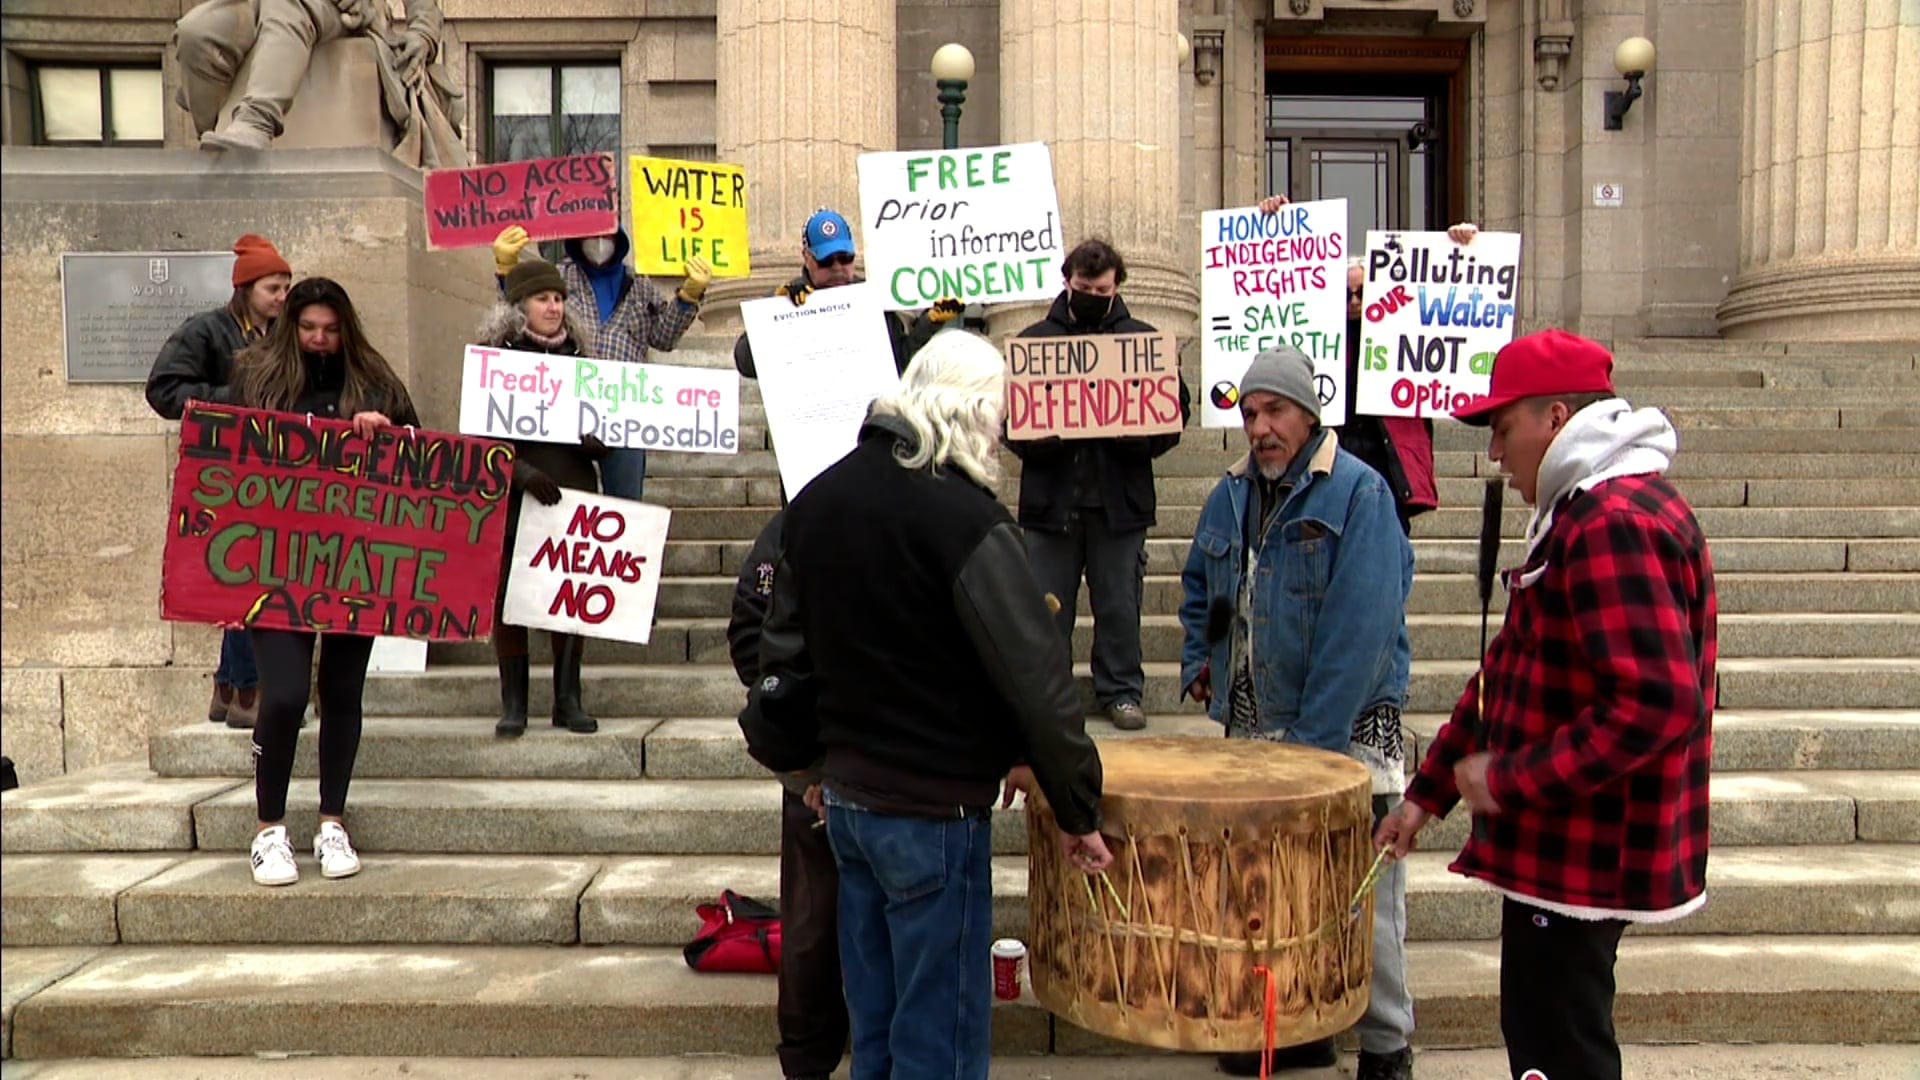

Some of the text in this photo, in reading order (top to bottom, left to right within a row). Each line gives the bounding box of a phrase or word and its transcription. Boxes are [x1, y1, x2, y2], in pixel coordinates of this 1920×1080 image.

[461, 156, 612, 199] NO ACCESS
[643, 166, 744, 208] WATER
[907, 152, 1011, 192] FREE
[434, 187, 617, 229] Without Consent
[680, 208, 704, 232] IS
[875, 199, 969, 229] prior
[1218, 207, 1313, 242] HONOUR
[662, 236, 728, 268] LIFE
[930, 211, 1057, 258] informed
[1206, 232, 1342, 269] INDIGENOUS
[891, 257, 1051, 306] CONSENT
[1233, 266, 1326, 300] RIGHTS
[1369, 247, 1516, 300] Polluting
[1244, 302, 1309, 332] SAVE
[1365, 285, 1514, 328] OUR Water
[1010, 337, 1165, 376] DEFEND THE
[1214, 335, 1250, 352] THE
[1364, 337, 1388, 371] is
[1397, 334, 1467, 374] NOT
[470, 348, 721, 413] Treaty Rights are
[486, 392, 549, 437] Not
[1009, 375, 1180, 430] DEFENDERS
[184, 411, 513, 500] INDIGENOUS
[192, 466, 496, 545] SOVEREINTY
[566, 504, 626, 542] NO
[205, 522, 446, 603] CLIMATE
[529, 536, 646, 583] MEANS
[244, 587, 477, 639] ACTION
[548, 578, 616, 624] NO
